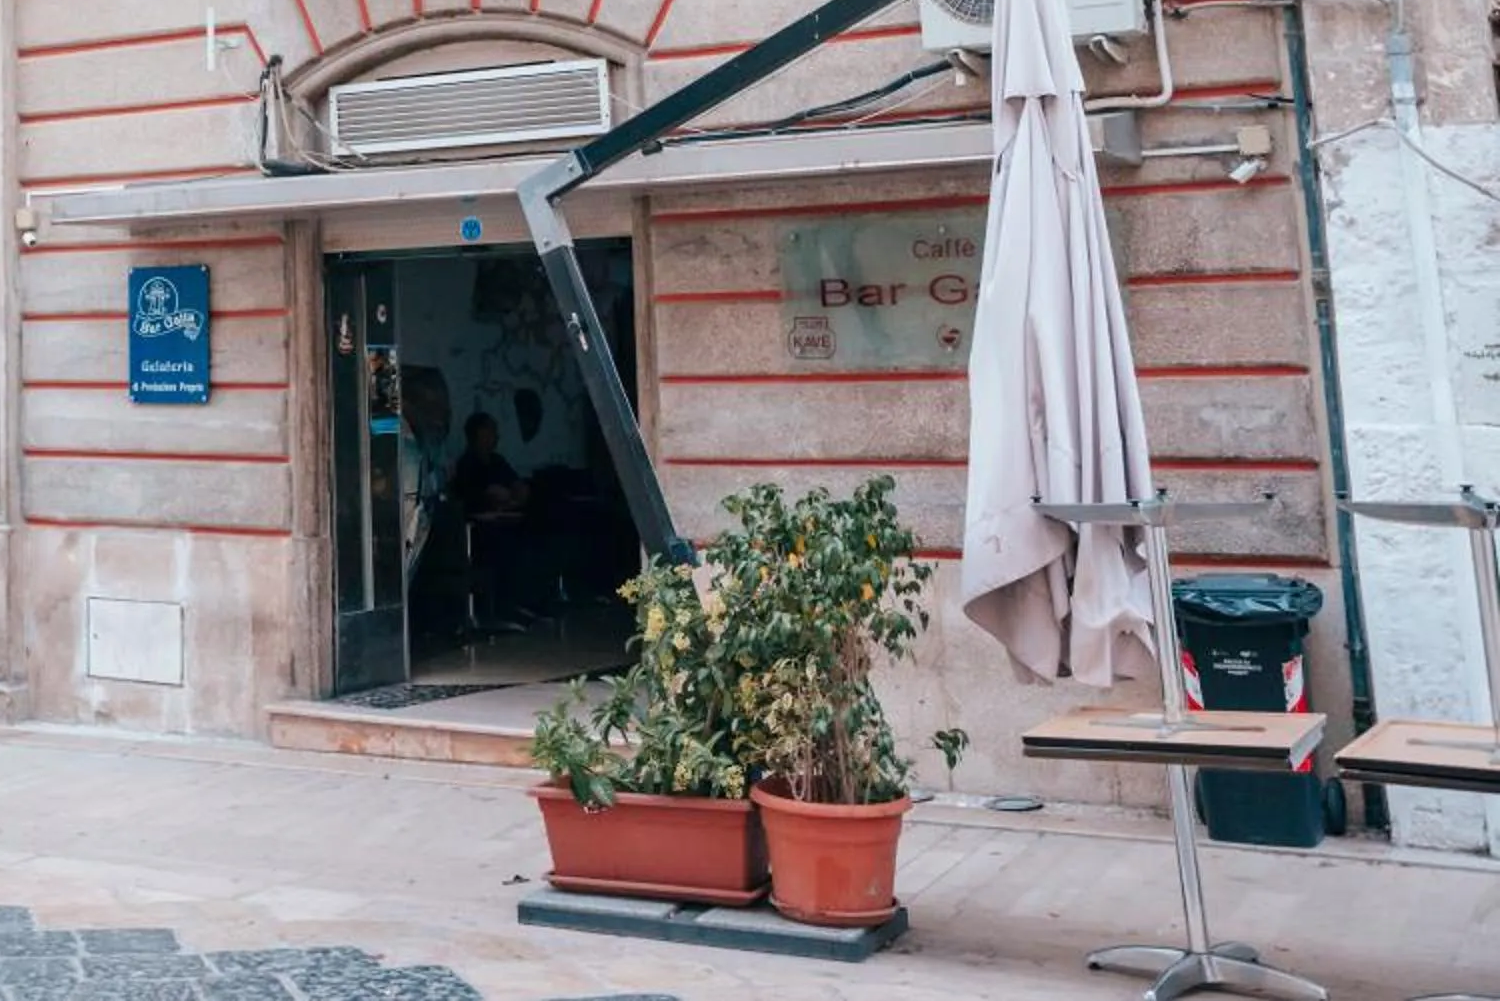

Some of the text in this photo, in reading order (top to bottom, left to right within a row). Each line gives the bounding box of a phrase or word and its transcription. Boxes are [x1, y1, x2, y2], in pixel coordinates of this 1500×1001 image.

[819, 273, 981, 308] Bar G
[141, 359, 195, 373] Gelateria
